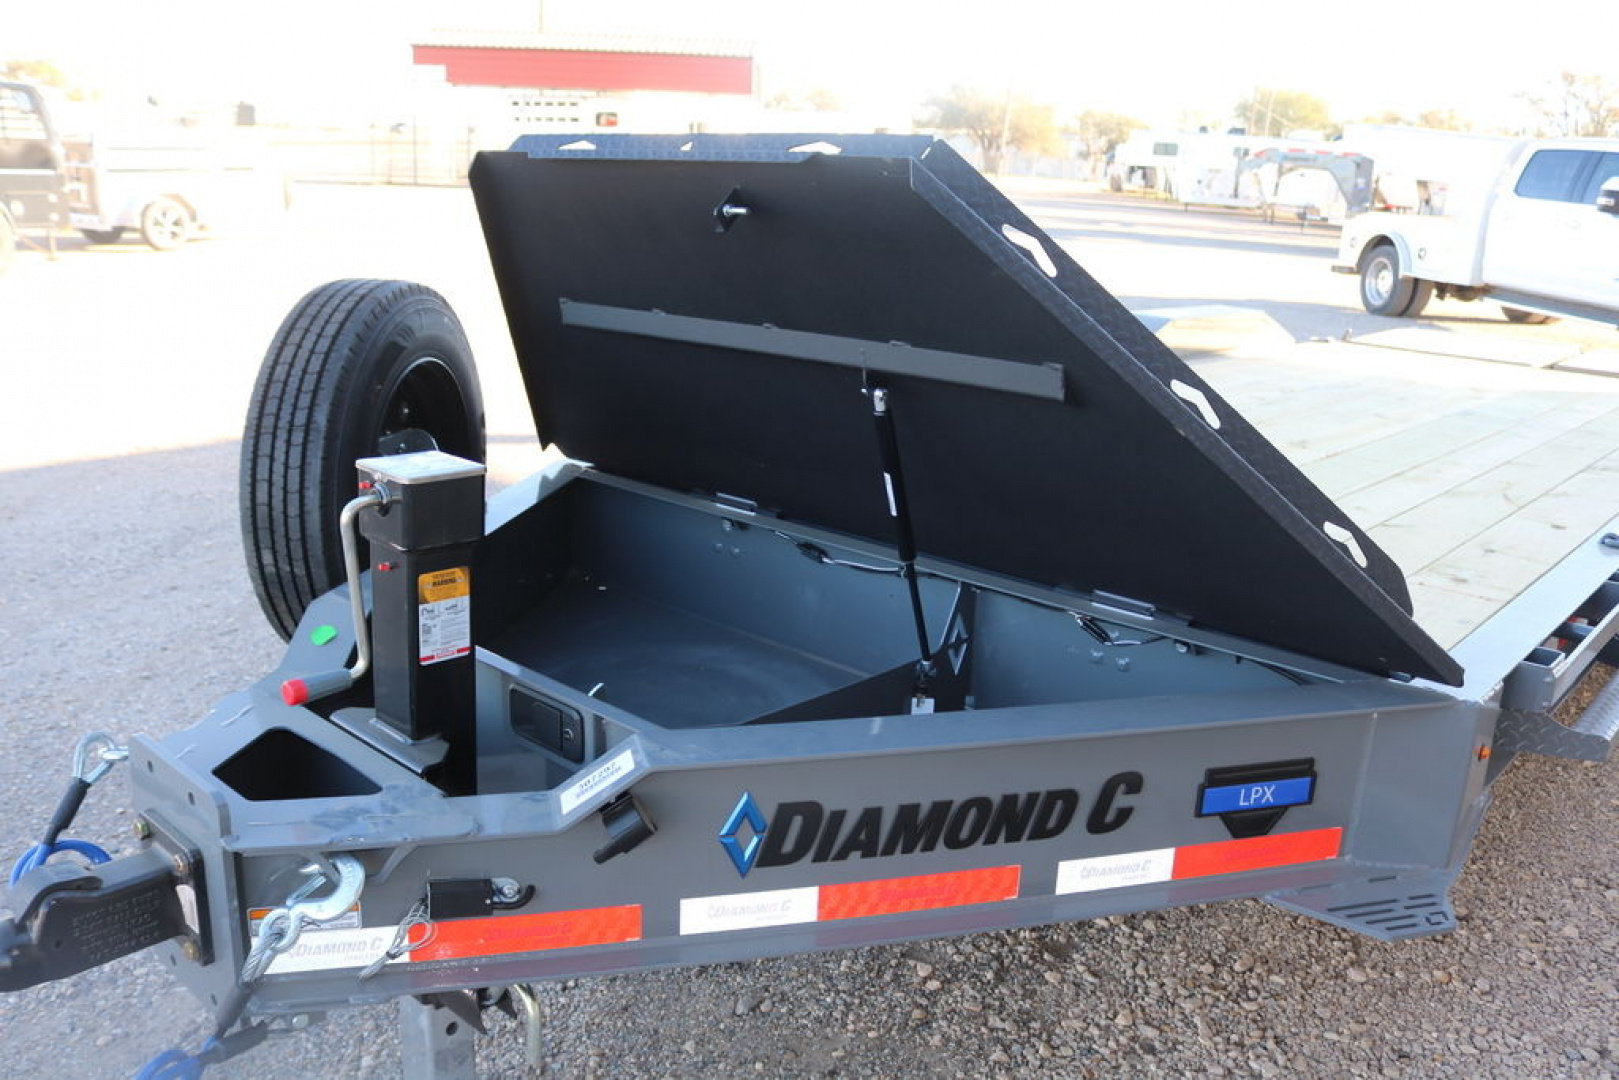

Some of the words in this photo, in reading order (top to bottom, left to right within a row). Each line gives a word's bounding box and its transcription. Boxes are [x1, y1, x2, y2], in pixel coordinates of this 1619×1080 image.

[755, 788, 1080, 868] DIAMOND
[1086, 771, 1144, 836] C
[1239, 785, 1276, 806] LPX
